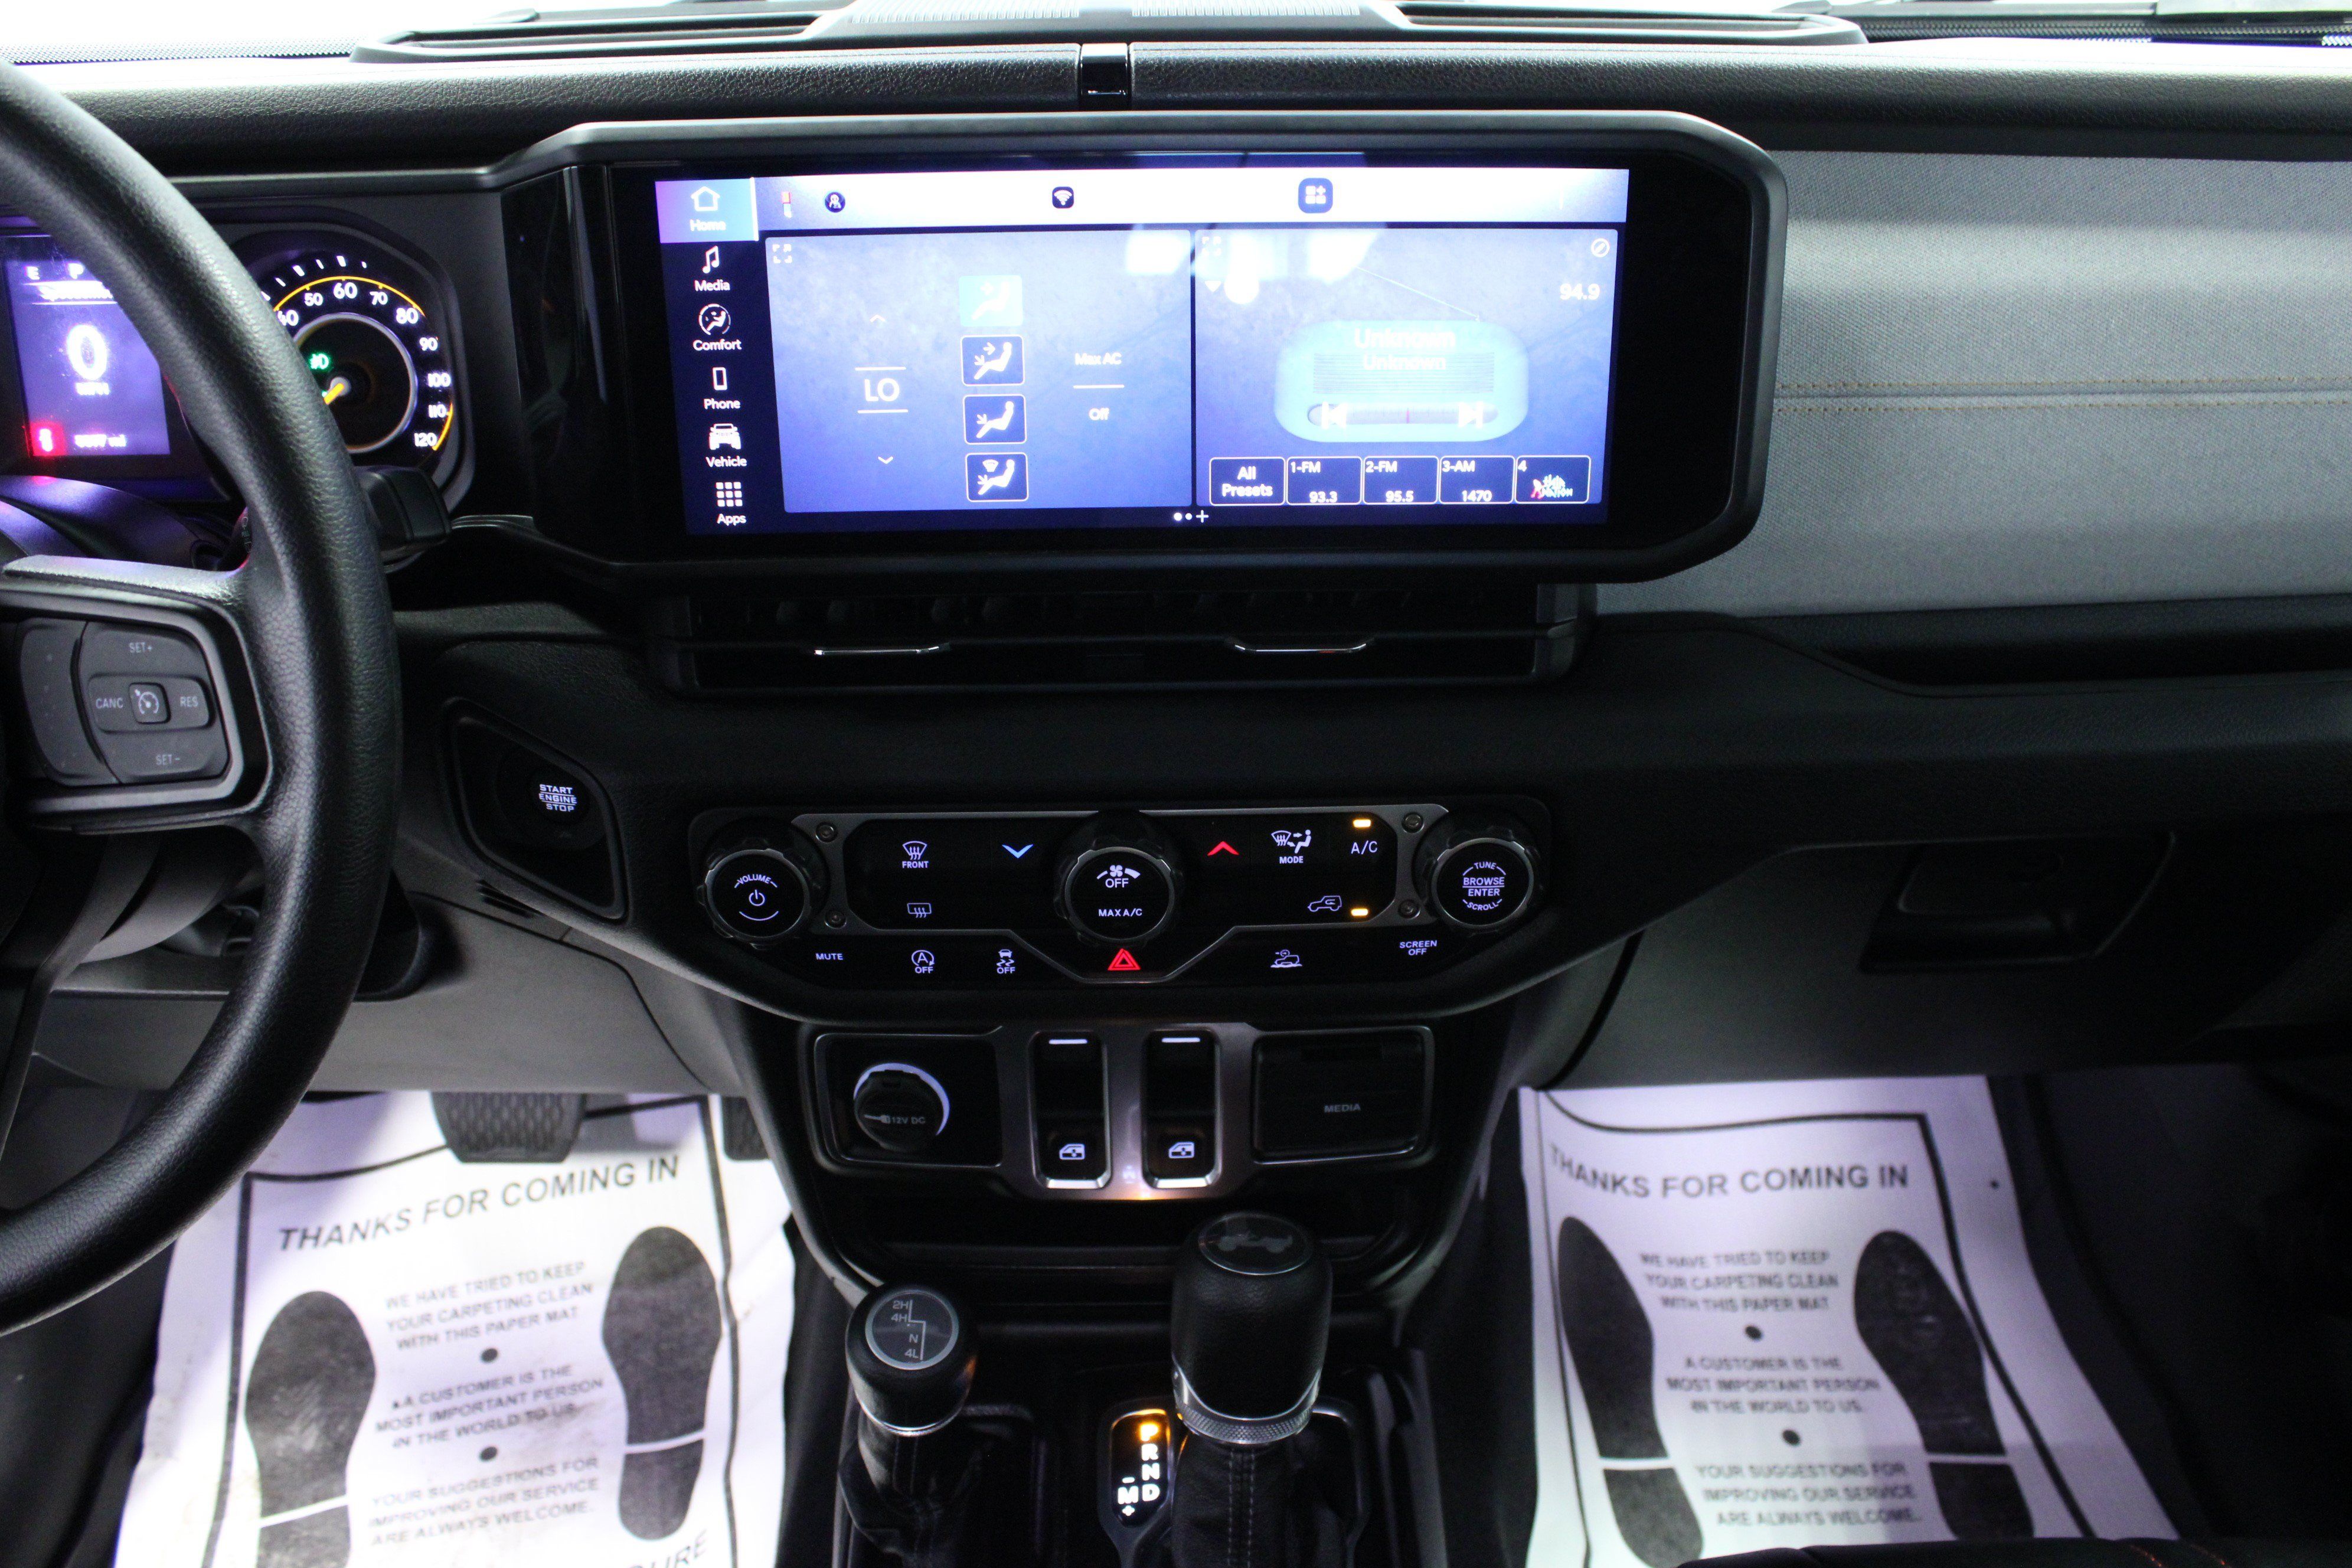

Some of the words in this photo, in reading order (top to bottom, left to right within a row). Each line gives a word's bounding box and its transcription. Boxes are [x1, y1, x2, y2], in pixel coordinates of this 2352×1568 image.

[690, 219, 727, 232] Home
[67, 263, 84, 279] P
[333, 282, 358, 299] 60
[694, 278, 730, 292] Media
[1560, 283, 1600, 300] 94.9
[304, 292, 324, 306] 50
[370, 291, 388, 305] 70
[277, 309, 299, 326] 40
[396, 307, 419, 325] 80
[419, 337, 438, 351] 90
[692, 338, 742, 351] Comfort
[1354, 328, 1456, 349] Unknown
[67, 324, 108, 381] 0
[1076, 352, 1100, 366] Max
[1101, 352, 1122, 365] AC
[1363, 355, 1446, 371] Unknown
[427, 373, 452, 387] 100
[864, 378, 900, 404] LO
[704, 397, 741, 410] Phone
[428, 404, 447, 418] 110
[1089, 408, 1110, 421] Off
[414, 432, 437, 447] 120
[705, 455, 747, 468] Vehicle
[1290, 460, 1321, 473] 1-FM
[1366, 460, 1397, 473] 2-FM
[1442, 460, 1475, 472] 3-AM
[1517, 460, 1527, 472] 4
[1237, 466, 1256, 480] All
[1221, 483, 1273, 497] Presets
[1309, 491, 1337, 503] 93.3
[1386, 490, 1414, 503] 95.5
[1462, 490, 1492, 503] 1470
[717, 512, 746, 527] Apps
[95, 697, 124, 710] CANC
[179, 695, 199, 708] RES
[540, 784, 573, 794] START
[538, 793, 577, 804] ENGINE
[546, 803, 574, 812] STOP
[1351, 840, 1378, 855] A/C
[901, 861, 929, 869] FRONT
[1279, 855, 1304, 864] MODE
[1474, 861, 1497, 871] TUNE
[737, 874, 772, 885] VOLUME
[1105, 878, 1129, 888] OFF
[1463, 877, 1505, 886] BROWSE
[1468, 888, 1500, 897] ENTER
[1098, 909, 1121, 917] MAX
[1123, 908, 1142, 917] A/C
[1466, 901, 1499, 912] SCROLL
[1399, 940, 1438, 949] SCREEN
[1408, 948, 1427, 956] OFF
[914, 966, 933, 974] OFF
[997, 966, 1015, 974] OFF
[1323, 1103, 1361, 1113] MEDIA
[891, 1115, 909, 1125] 12V
[911, 1115, 926, 1125] DC
[1550, 1142, 1650, 1198] THANKS
[1661, 1172, 1729, 1198] FOR
[1739, 1164, 1869, 1194] COMING
[1879, 1163, 1909, 1189] IN
[279, 1207, 412, 1252] THANKS
[422, 1188, 489, 1224] FOR
[502, 1162, 635, 1207] COMING
[648, 1154, 678, 1183] IN
[1765, 1250, 1786, 1265] TO
[1789, 1249, 1830, 1265] KEEP
[386, 1292, 410, 1310] WE
[415, 1283, 460, 1304] HAVE
[465, 1273, 512, 1295] TRIED
[517, 1268, 538, 1285] TO
[542, 1260, 586, 1279] KEEP
[1645, 1273, 1687, 1288] YOUR
[1691, 1273, 1783, 1290] CARPETING
[1787, 1272, 1839, 1289] CLEAN
[386, 1312, 433, 1332] YOUR
[437, 1293, 534, 1323] CARPETING
[537, 1282, 596, 1305] CLEAN
[892, 1300, 909, 1309] 2H
[1742, 1296, 1792, 1312] PAPER
[890, 1313, 907, 1323] 4H
[397, 1332, 440, 1351] WITH
[444, 1323, 481, 1342] THIS
[485, 1312, 540, 1335] PAPER
[545, 1305, 579, 1323] MAT
[909, 1334, 919, 1343] N
[904, 1348, 919, 1358] 4L
[1700, 1357, 1789, 1371] CUSTOMER
[419, 1374, 514, 1404] CUSTOMER
[519, 1371, 534, 1385] IS
[541, 1364, 572, 1380] THE
[1666, 1377, 1711, 1393] MOST
[1717, 1377, 1808, 1393] IMPORTANT
[1812, 1377, 1880, 1391] PERSON
[375, 1412, 424, 1432] MOST
[429, 1390, 528, 1423] IMPORTANT
[532, 1377, 605, 1402] PERSON
[416, 1429, 450, 1445] THE
[455, 1412, 520, 1438] WORLD
[524, 1407, 549, 1422] TO
[1139, 1423, 1159, 1442] P
[1142, 1443, 1159, 1461] R
[1142, 1463, 1160, 1481] N
[1747, 1462, 1868, 1479] SUGGESTIONS
[371, 1488, 422, 1507] YOUR
[427, 1463, 557, 1498] SUGGESTIONS
[561, 1455, 599, 1472] FOR
[1117, 1487, 1139, 1504] M
[1142, 1484, 1161, 1501] D
[368, 1498, 472, 1527] IMPROVING
[476, 1492, 518, 1509] OUR
[522, 1477, 599, 1502] SERVICE
[370, 1530, 410, 1546] ARE
[414, 1515, 489, 1540] ALWAYS
